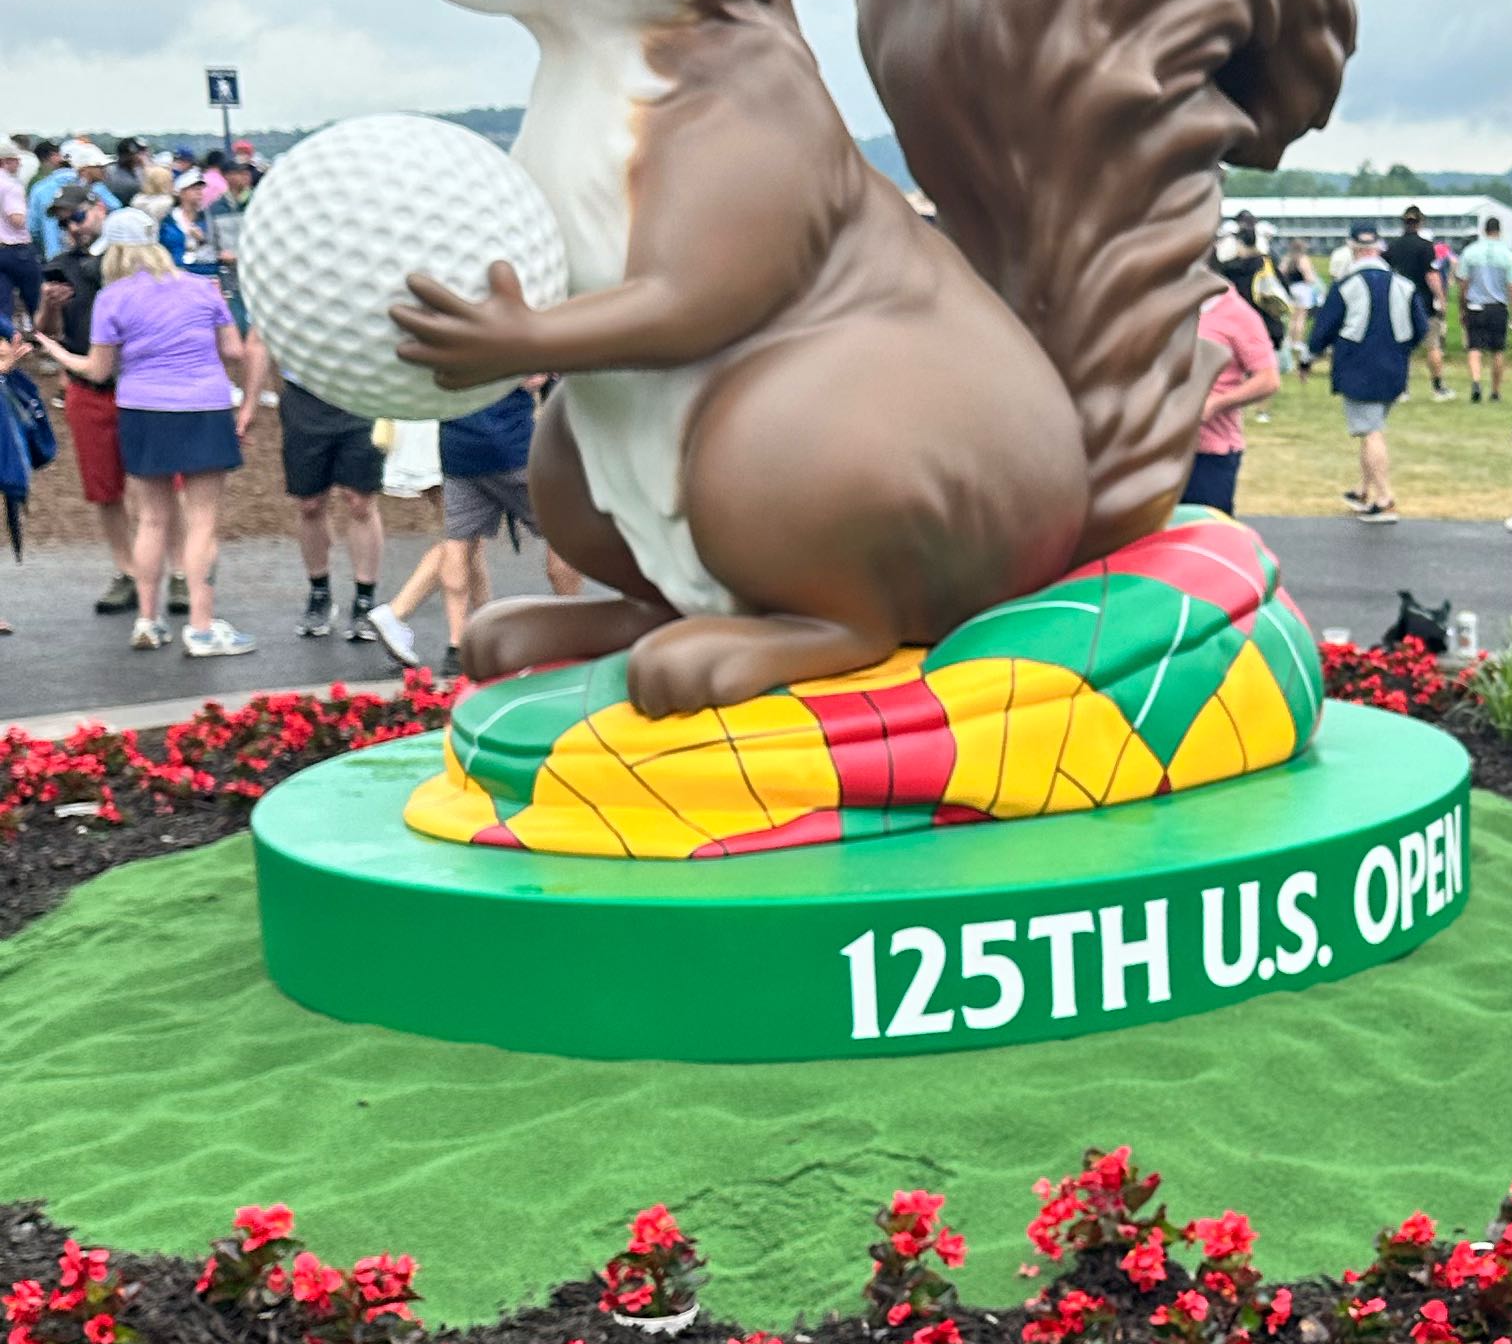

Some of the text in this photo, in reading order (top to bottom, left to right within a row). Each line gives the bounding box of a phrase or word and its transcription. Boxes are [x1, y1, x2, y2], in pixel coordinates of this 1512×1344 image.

[839, 803, 1463, 1040] 125TH U.S. OPEN
